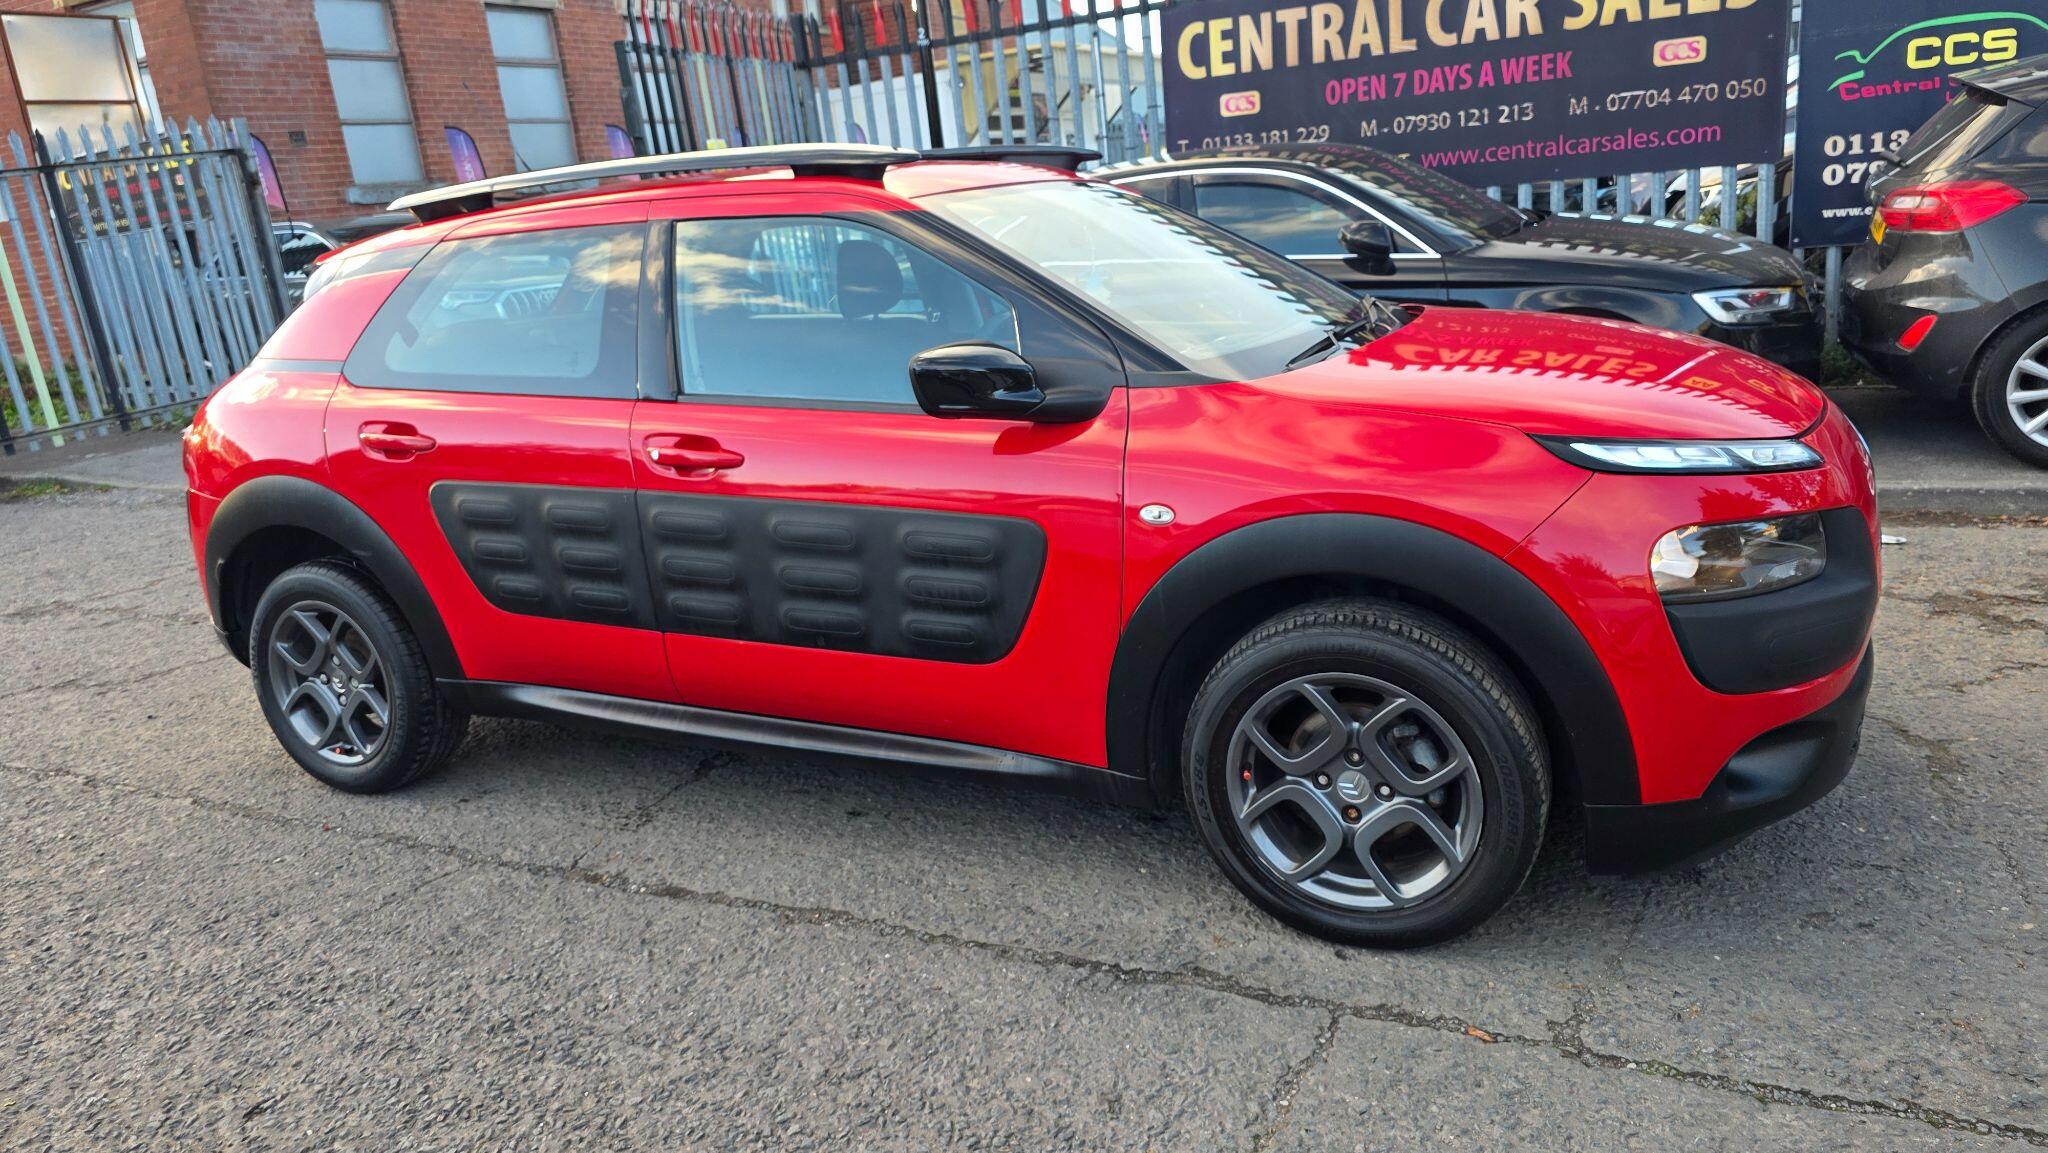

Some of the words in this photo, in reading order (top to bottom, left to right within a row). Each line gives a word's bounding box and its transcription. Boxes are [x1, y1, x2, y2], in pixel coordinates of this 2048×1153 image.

[1178, 0, 1417, 80] CENTRAL
[1425, 0, 1544, 47] CAR
[1658, 39, 1702, 63] CCS
[1906, 27, 2017, 70] CCS
[1325, 74, 1386, 105] OPEN
[1393, 73, 1406, 97] 7
[1413, 63, 1473, 96] DAYS
[1478, 60, 1495, 88] A
[1501, 51, 1573, 85] WEEK
[1839, 76, 1940, 101] Central
[1606, 88, 1671, 112] 07704
[1677, 82, 1719, 104] 470
[1726, 77, 1767, 99] 050
[1457, 107, 1489, 127] 121
[1498, 102, 1535, 124] 213
[1177, 139, 1190, 153] T
[1202, 132, 1254, 151] 01133
[1260, 129, 1289, 145] 181
[1297, 124, 1330, 144] 229
[1421, 124, 1722, 168] www.centralcarsales.com
[1823, 128, 1910, 157] 0113
